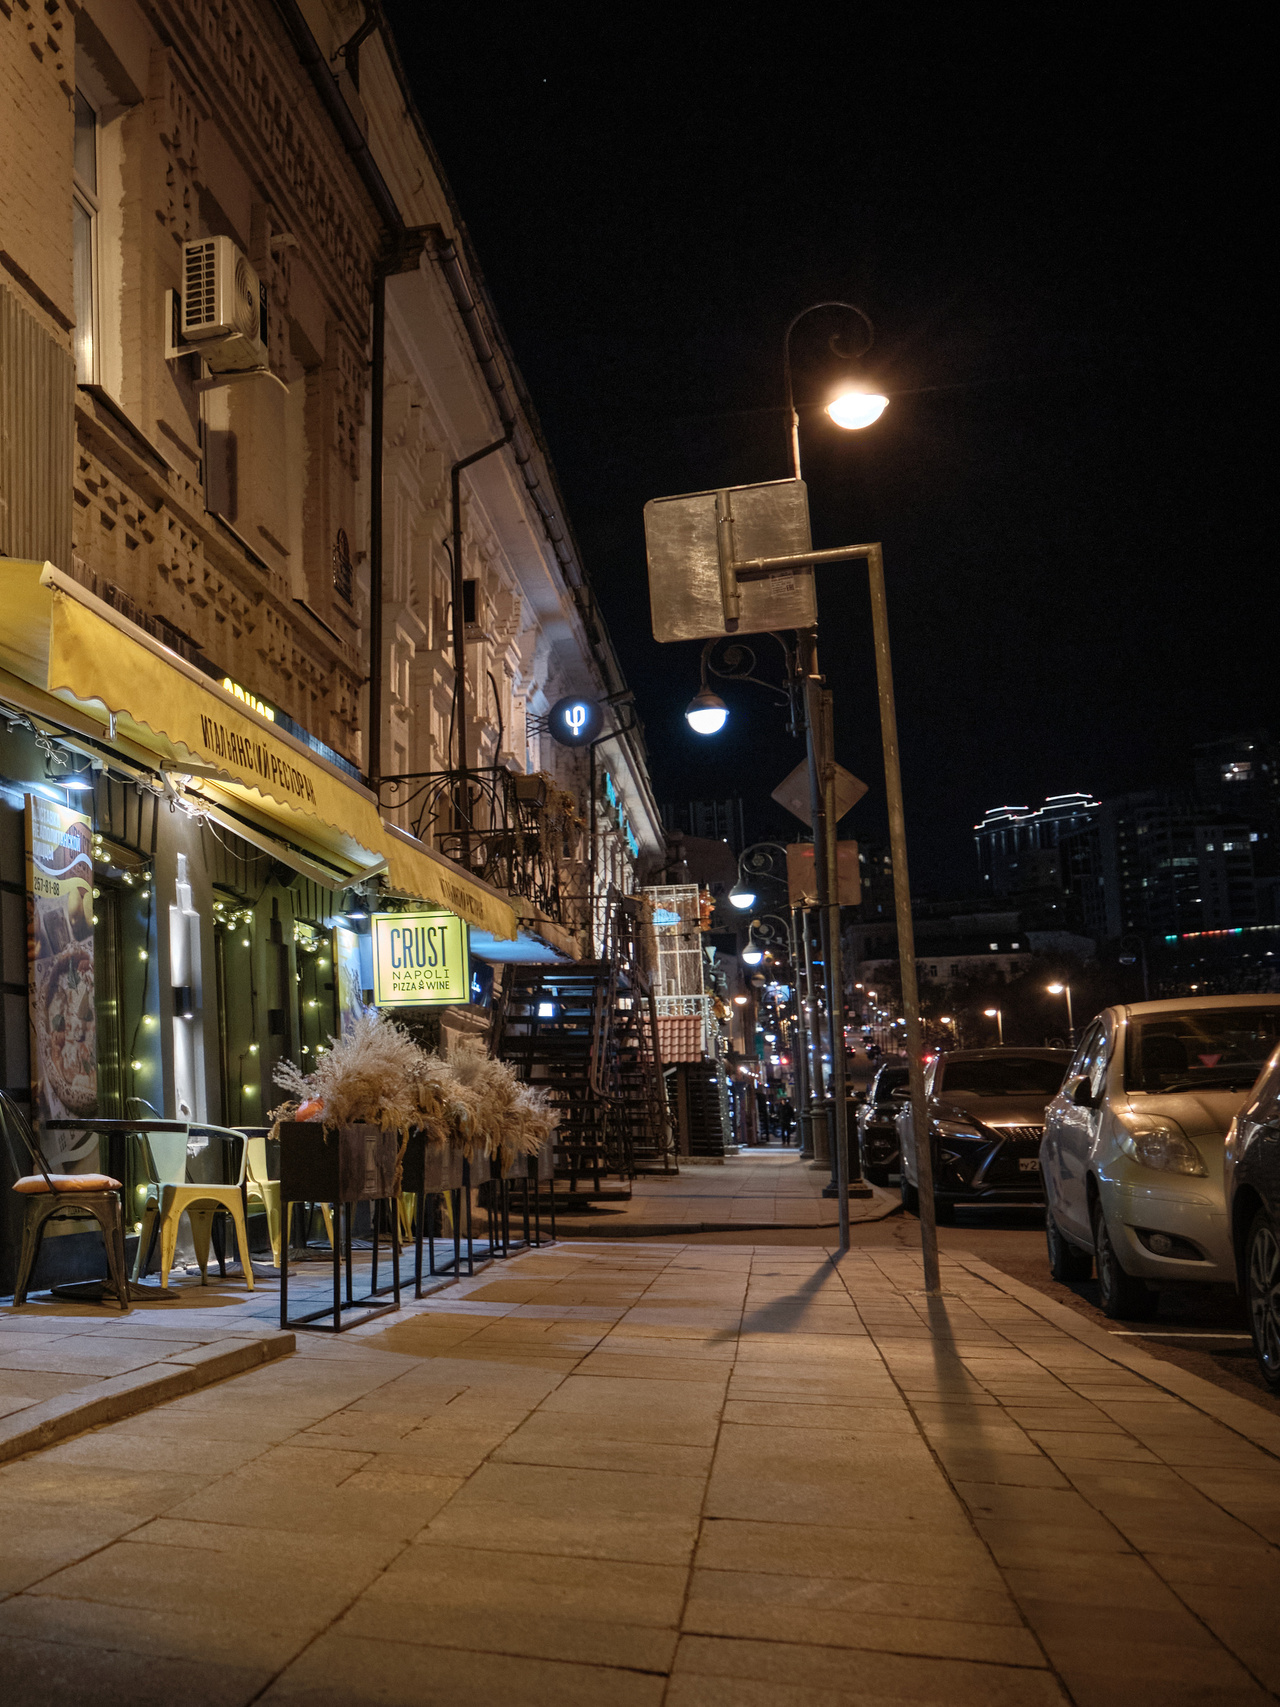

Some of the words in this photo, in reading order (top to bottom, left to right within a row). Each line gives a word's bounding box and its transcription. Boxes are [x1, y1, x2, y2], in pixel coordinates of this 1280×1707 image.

[33, 876, 60, 897] 257-81-88
[390, 925, 448, 969] CRUST
[392, 969, 450, 980] NAPOLI
[393, 982, 417, 991] PIZZA
[425, 980, 450, 990] WINE
